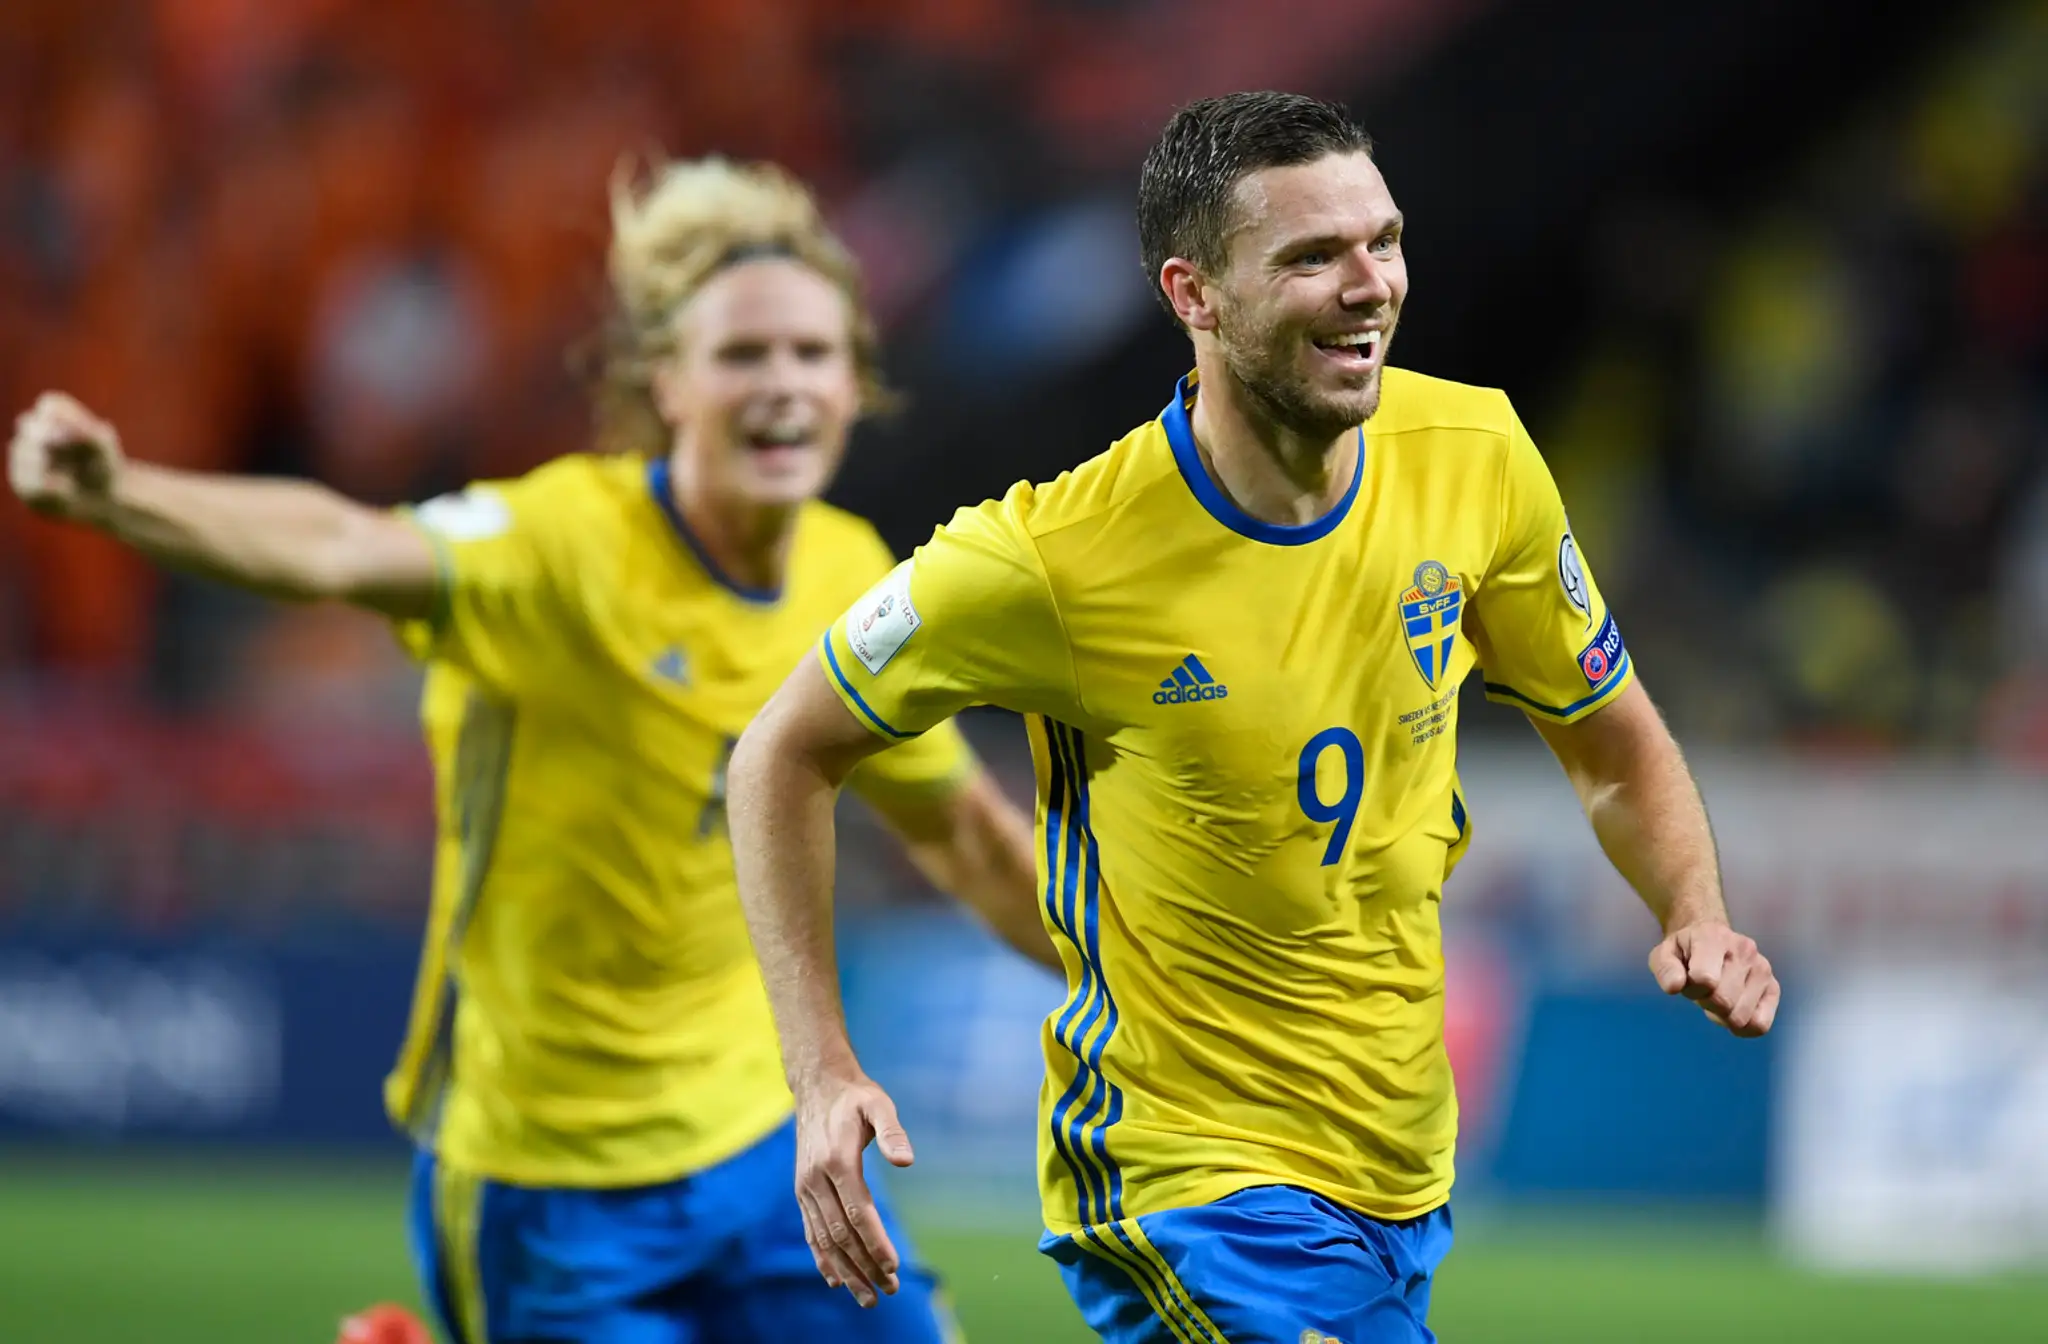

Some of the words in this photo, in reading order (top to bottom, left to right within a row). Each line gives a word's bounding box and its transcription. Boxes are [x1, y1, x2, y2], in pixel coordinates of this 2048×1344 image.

[1418, 597, 1451, 615] SvFF
[1152, 684, 1228, 705] adidas
[1397, 708, 1424, 725] SWEDEN
[1297, 726, 1365, 867] 9
